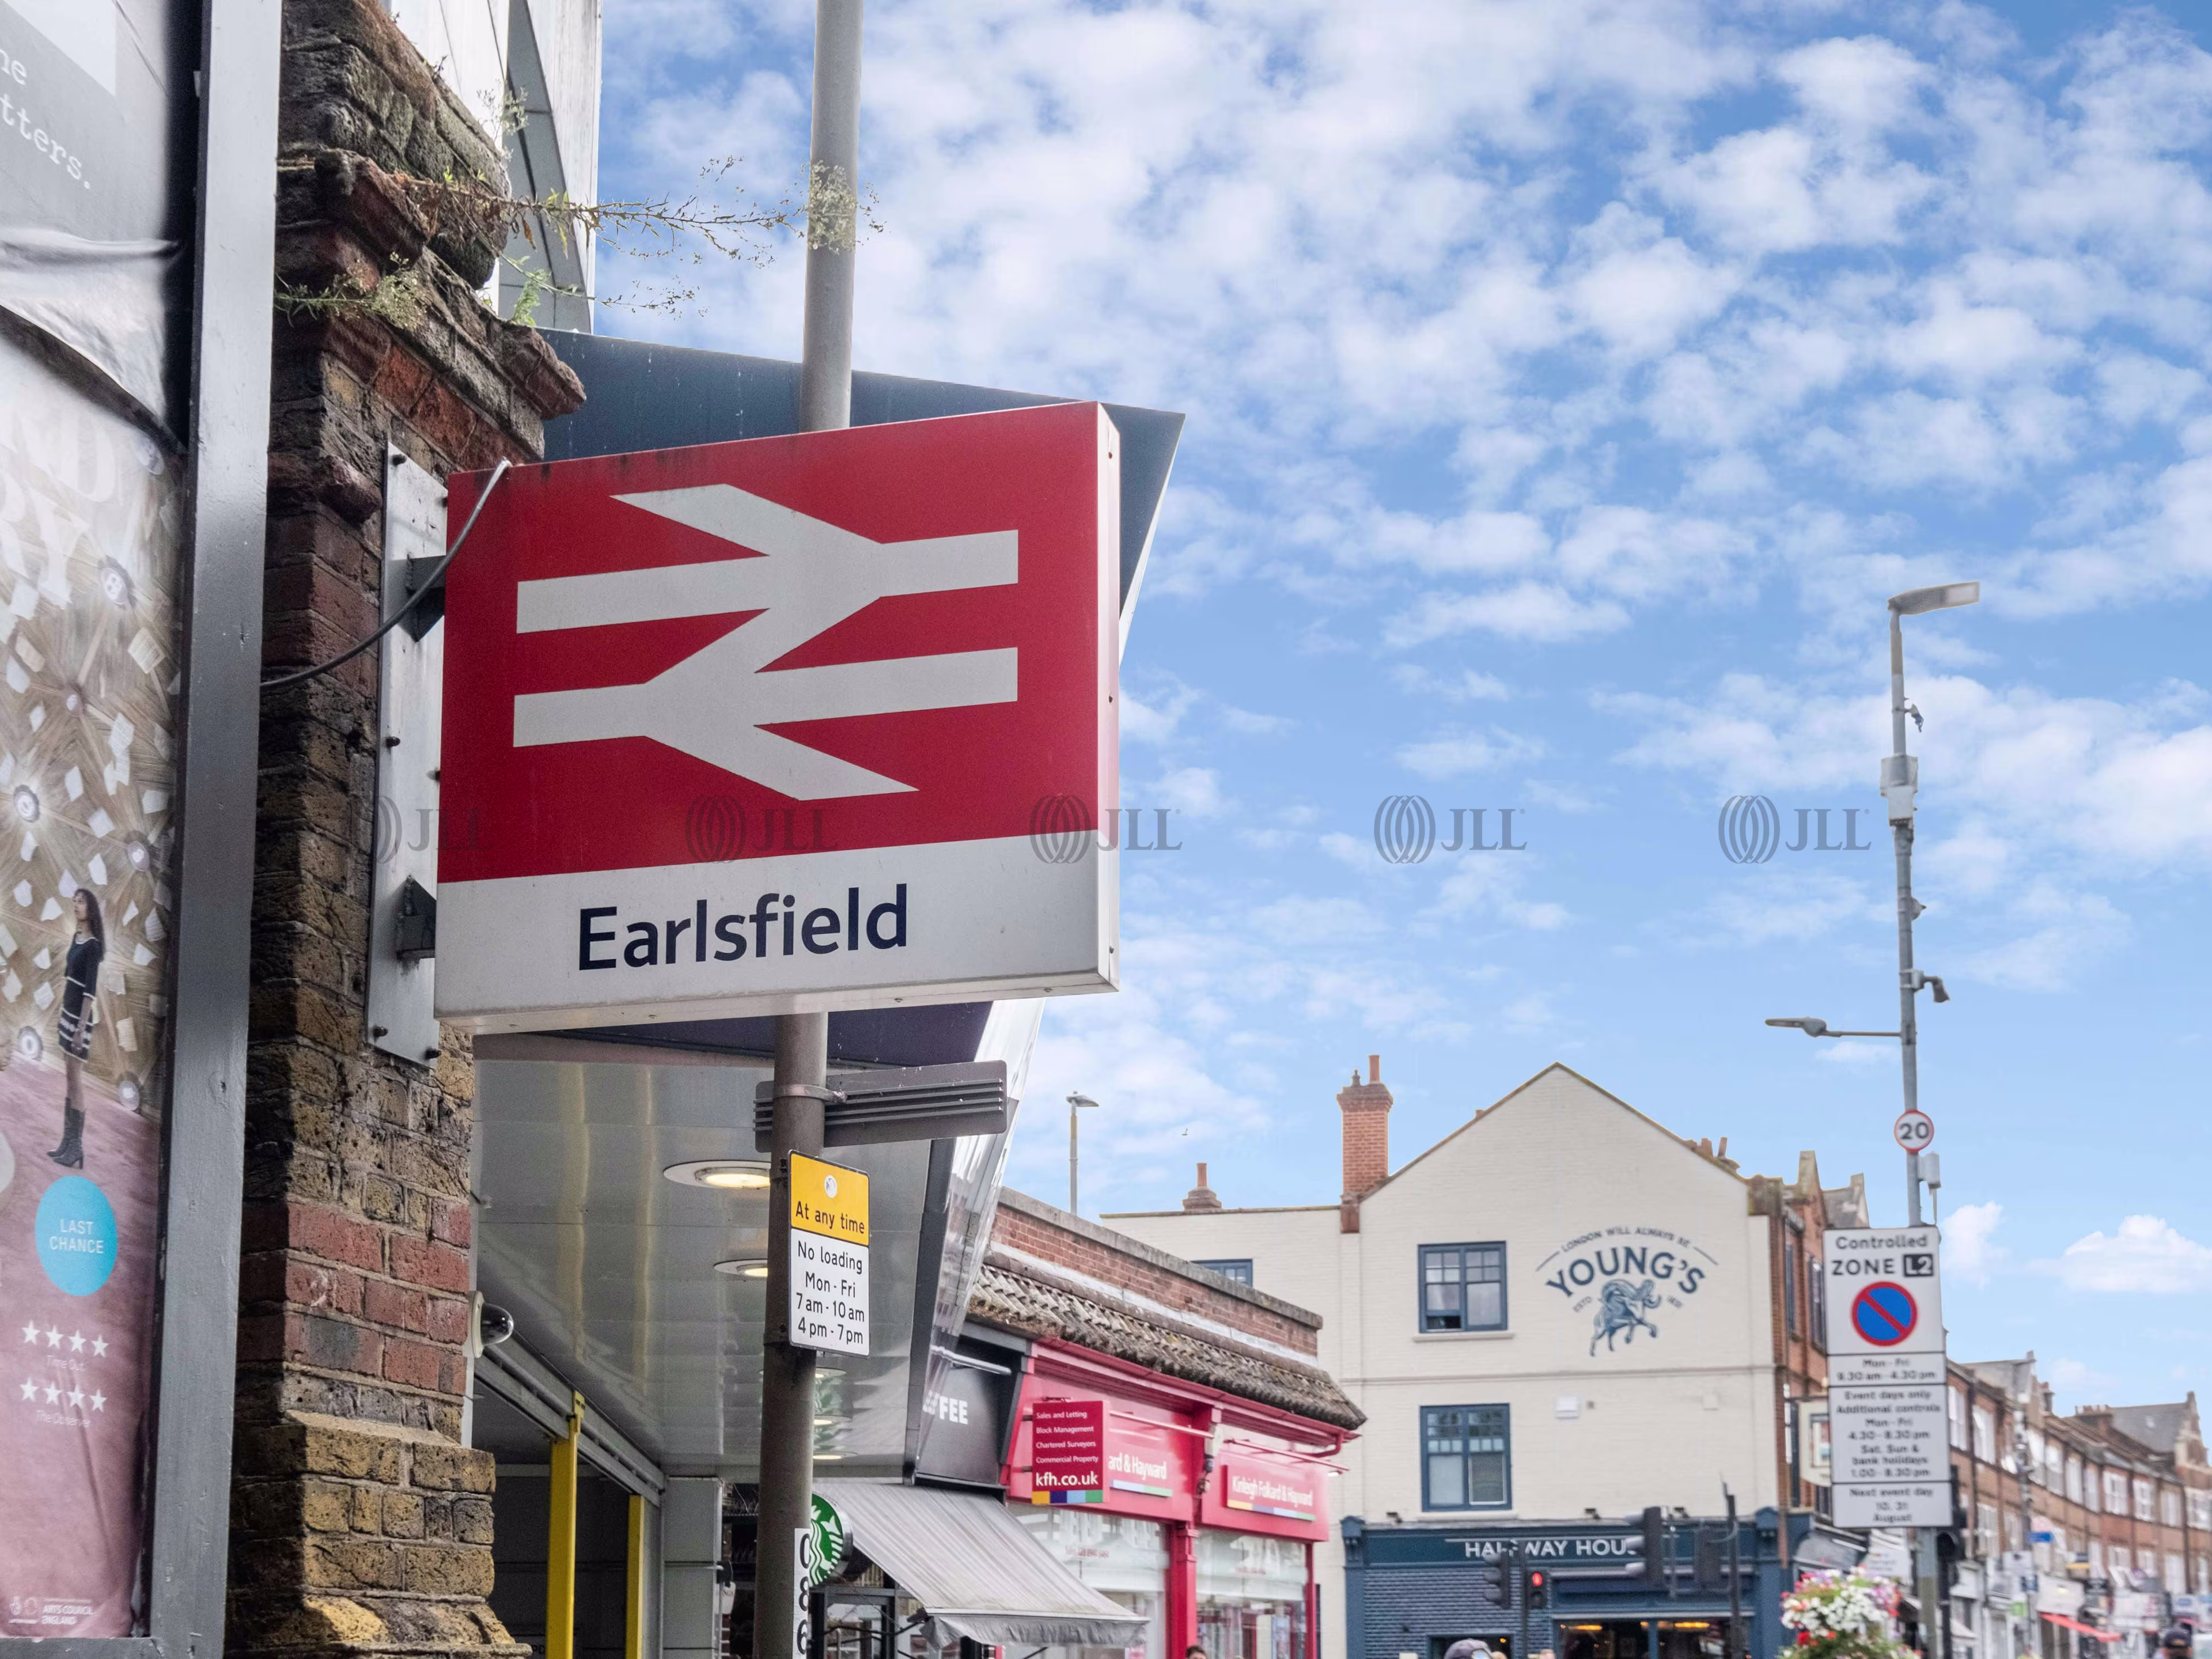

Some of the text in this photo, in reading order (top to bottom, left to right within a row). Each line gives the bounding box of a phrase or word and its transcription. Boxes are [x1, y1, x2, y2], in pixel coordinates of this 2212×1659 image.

[579, 883, 907, 971] Earlsfield
[1900, 1122, 1929, 1139] 20
[60, 1218, 94, 1234] LAST
[796, 1201, 865, 1234] At any time
[49, 1236, 104, 1254] CHANCE
[1561, 1231, 1602, 1252] LONDON
[1606, 1226, 1630, 1236] WILL
[1836, 1234, 1927, 1249] Controlled
[798, 1240, 862, 1275] No loading
[1832, 1256, 1931, 1275] ZONE L2
[1546, 1247, 1705, 1298] YOUNG'S
[806, 1271, 830, 1293] Mon
[841, 1279, 855, 1298] Fri
[1066, 1411, 1088, 1419] Letting
[1054, 1426, 1094, 1434] Management
[1067, 1441, 1096, 1449] Surveyors
[1073, 1456, 1099, 1464] Property
[1123, 1455, 1131, 1472] &
[1132, 1456, 1166, 1480] Hayward
[1036, 1471, 1099, 1486] kfh.co.uk
[43, 1605, 62, 1613] ARTS
